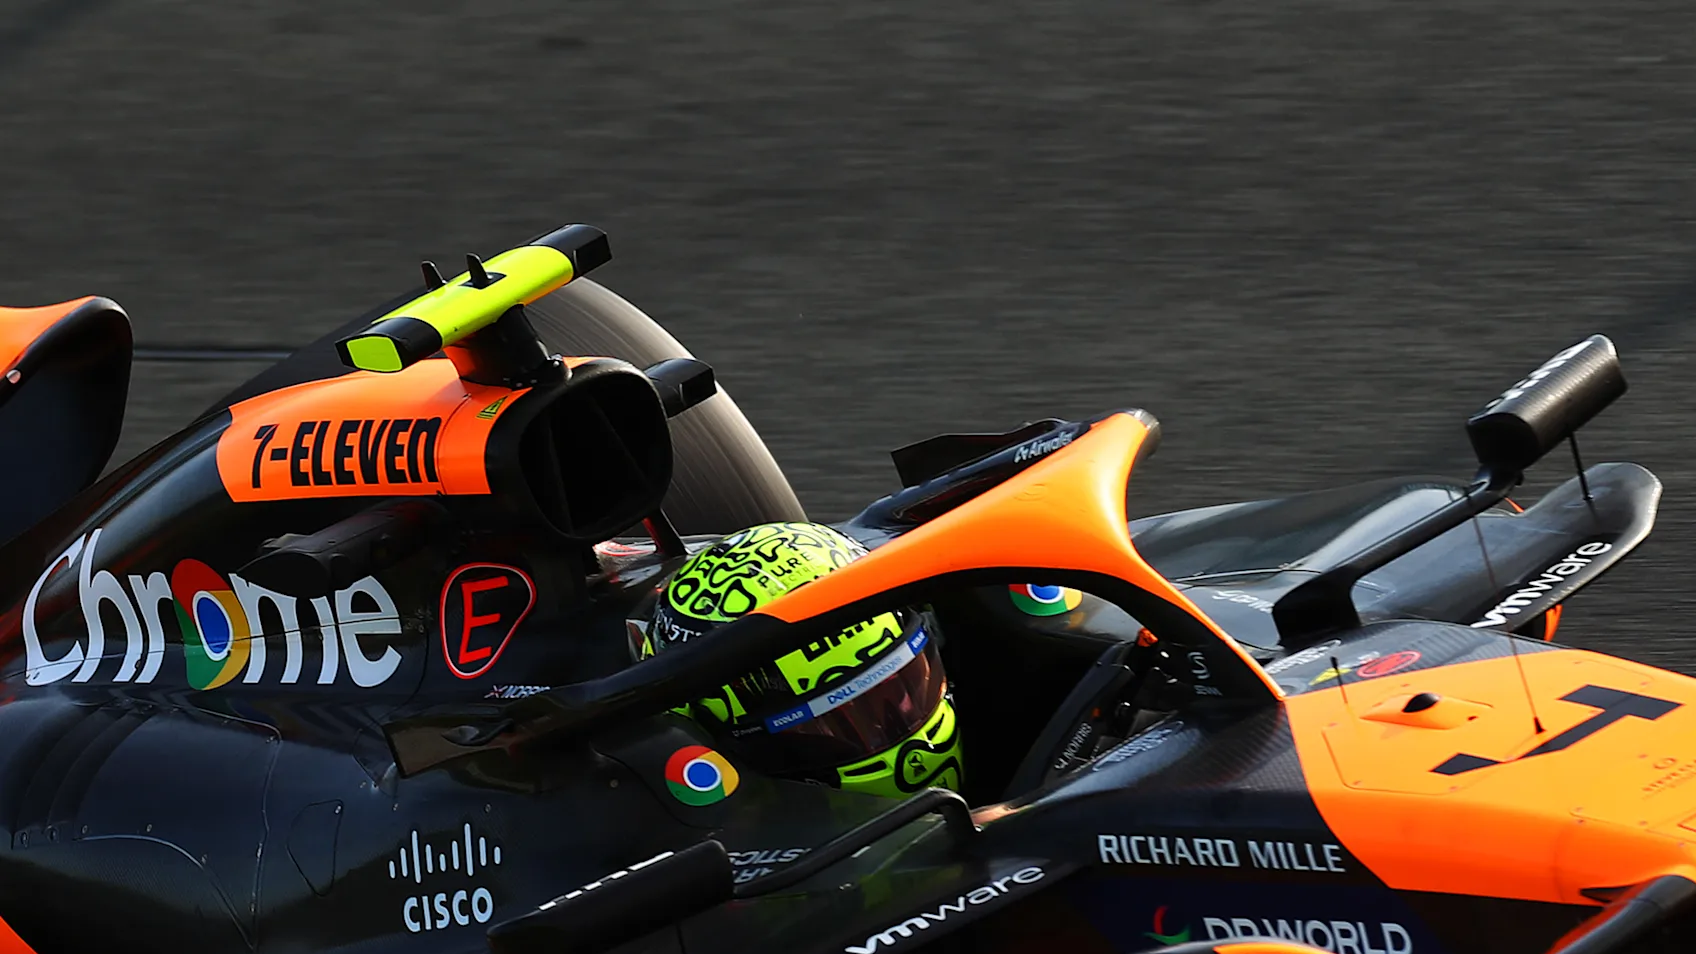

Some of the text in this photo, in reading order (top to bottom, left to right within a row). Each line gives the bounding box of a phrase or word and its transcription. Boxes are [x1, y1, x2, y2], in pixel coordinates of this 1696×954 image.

[251, 416, 442, 489] 7-ELEVEN
[22, 528, 402, 690] Chrome
[458, 575, 509, 664] E
[1472, 538, 1612, 629] vmware
[1097, 834, 1346, 873] RICHARD MILLE
[403, 887, 494, 933] CISCO
